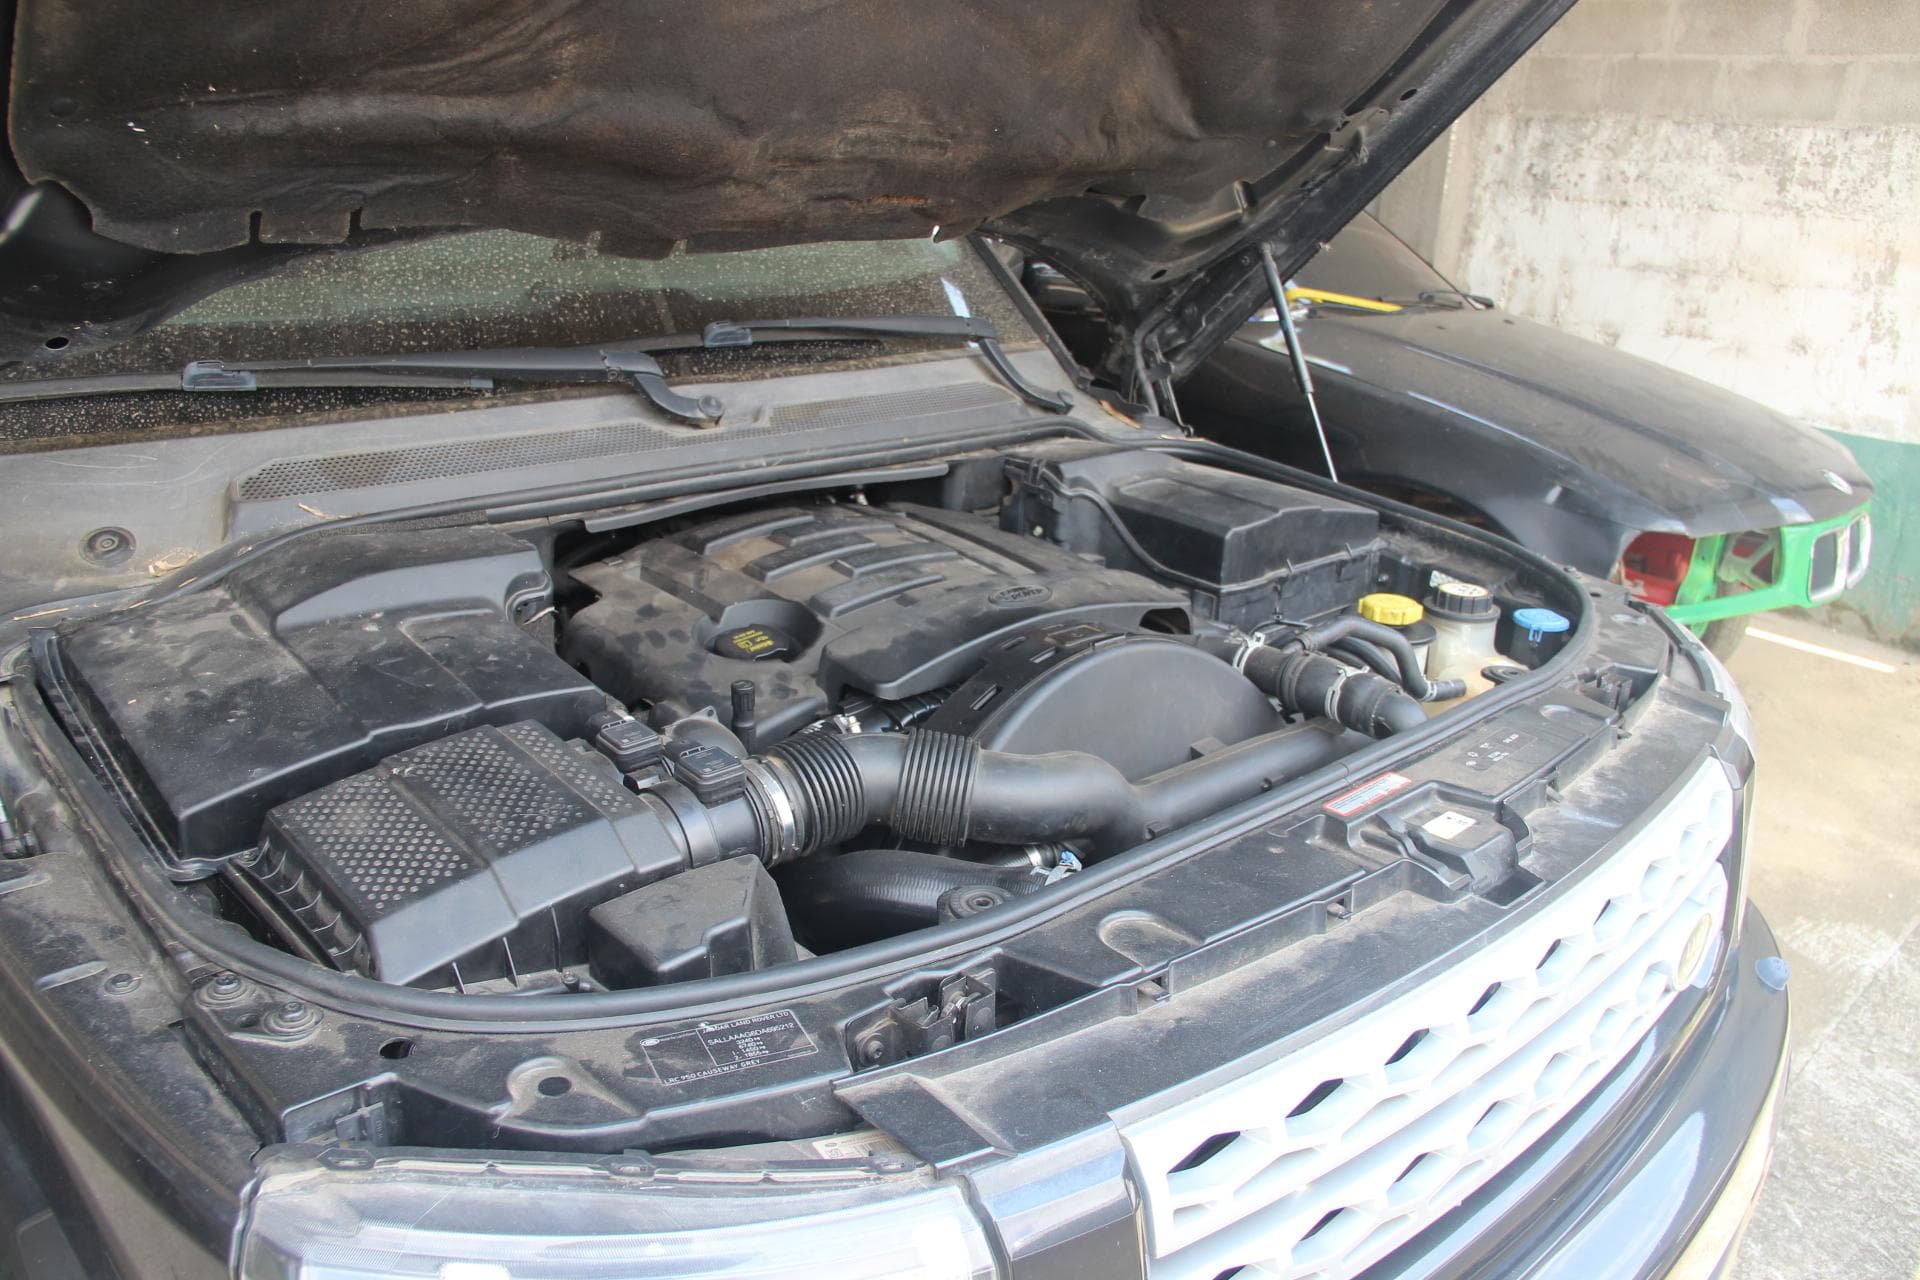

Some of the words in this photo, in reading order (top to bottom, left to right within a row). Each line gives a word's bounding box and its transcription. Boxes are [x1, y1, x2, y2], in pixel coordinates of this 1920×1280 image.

[664, 1076, 680, 1084] LRC
[697, 1064, 738, 1077] CAUSEWAY
[740, 1059, 760, 1067] GREY
